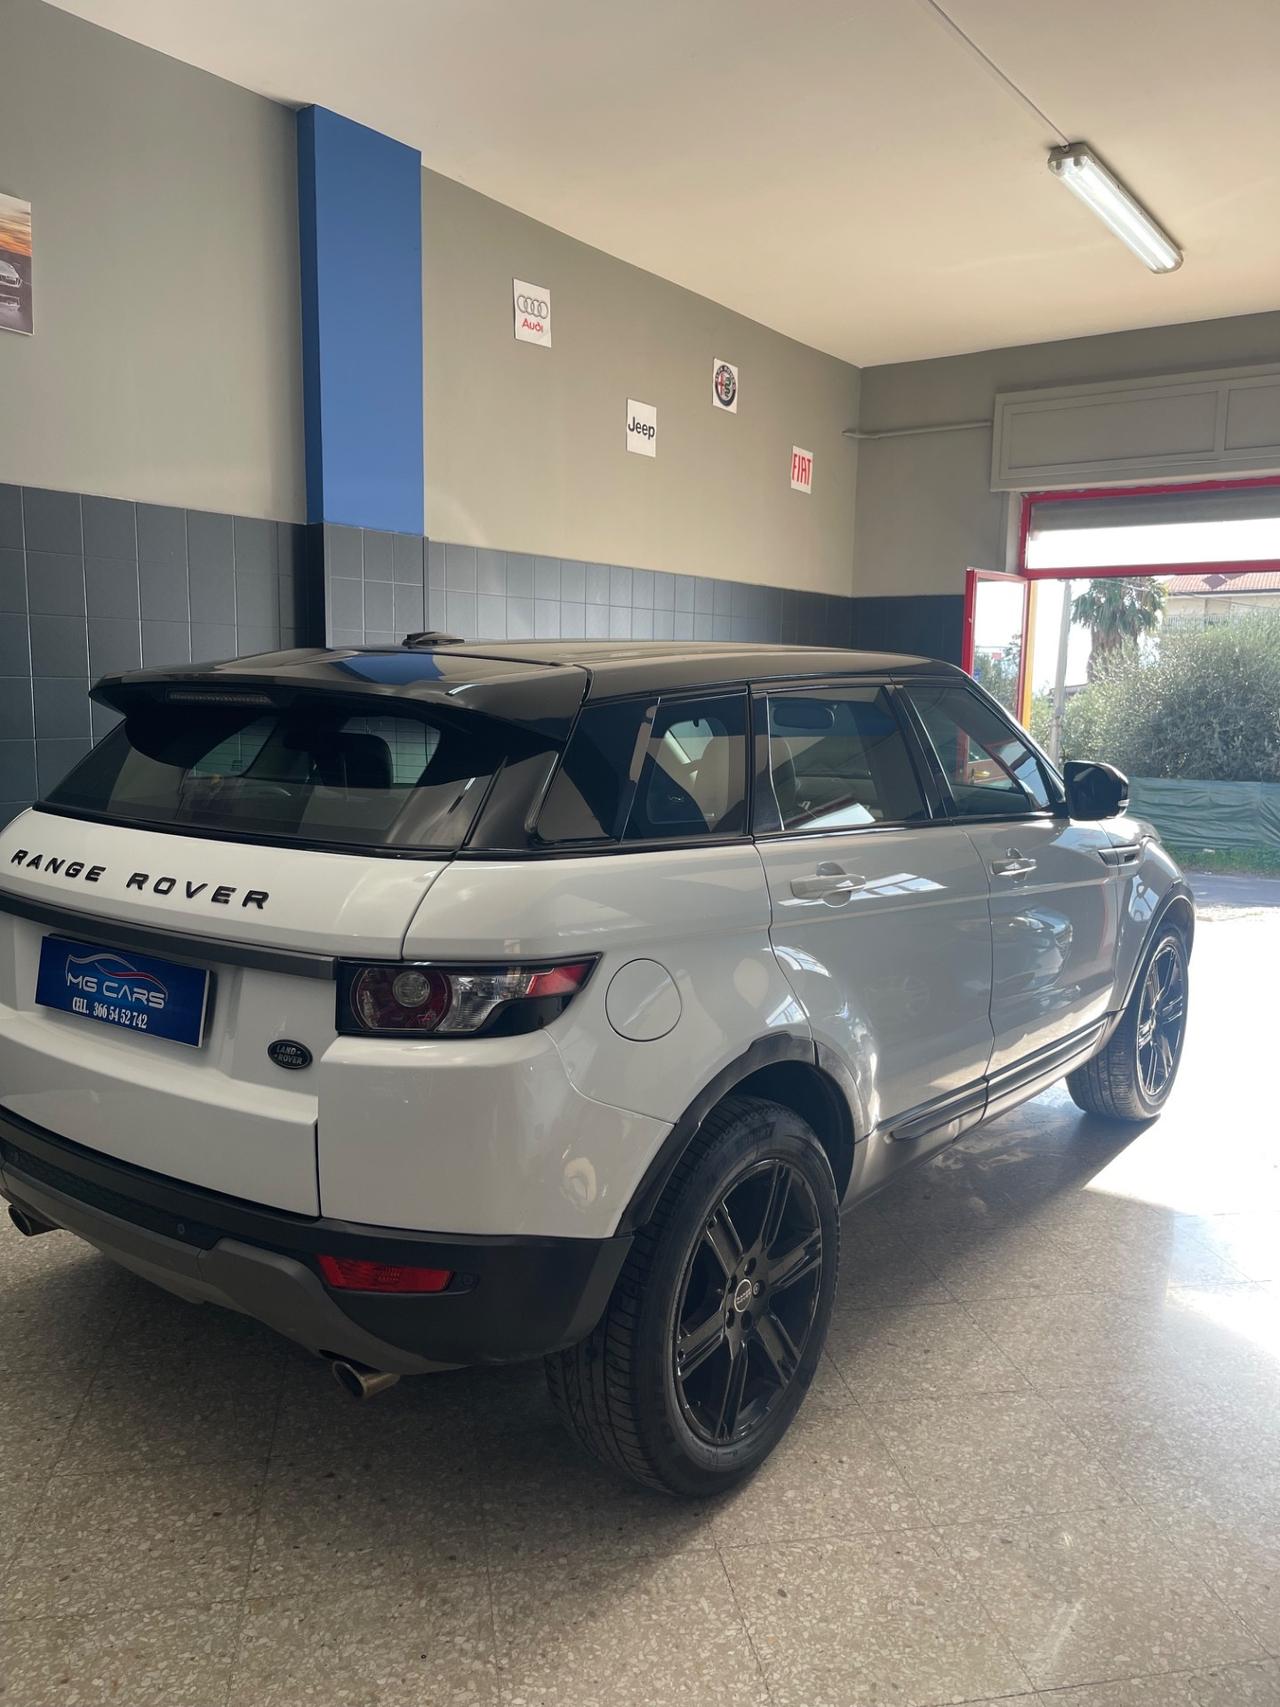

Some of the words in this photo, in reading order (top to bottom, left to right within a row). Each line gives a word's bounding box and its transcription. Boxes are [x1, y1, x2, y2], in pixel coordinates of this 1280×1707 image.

[521, 317, 544, 333] Audi
[627, 416, 656, 441] Jeep
[792, 453, 812, 486] FIAT
[10, 849, 107, 882] RANGE
[125, 872, 270, 910] ROVER
[66, 972, 98, 993] MG
[102, 981, 166, 1009] CARS
[93, 1002, 108, 1019] 366
[108, 1006, 119, 1022] 54
[120, 1009, 131, 1026] 52
[132, 1012, 149, 1029] 742
